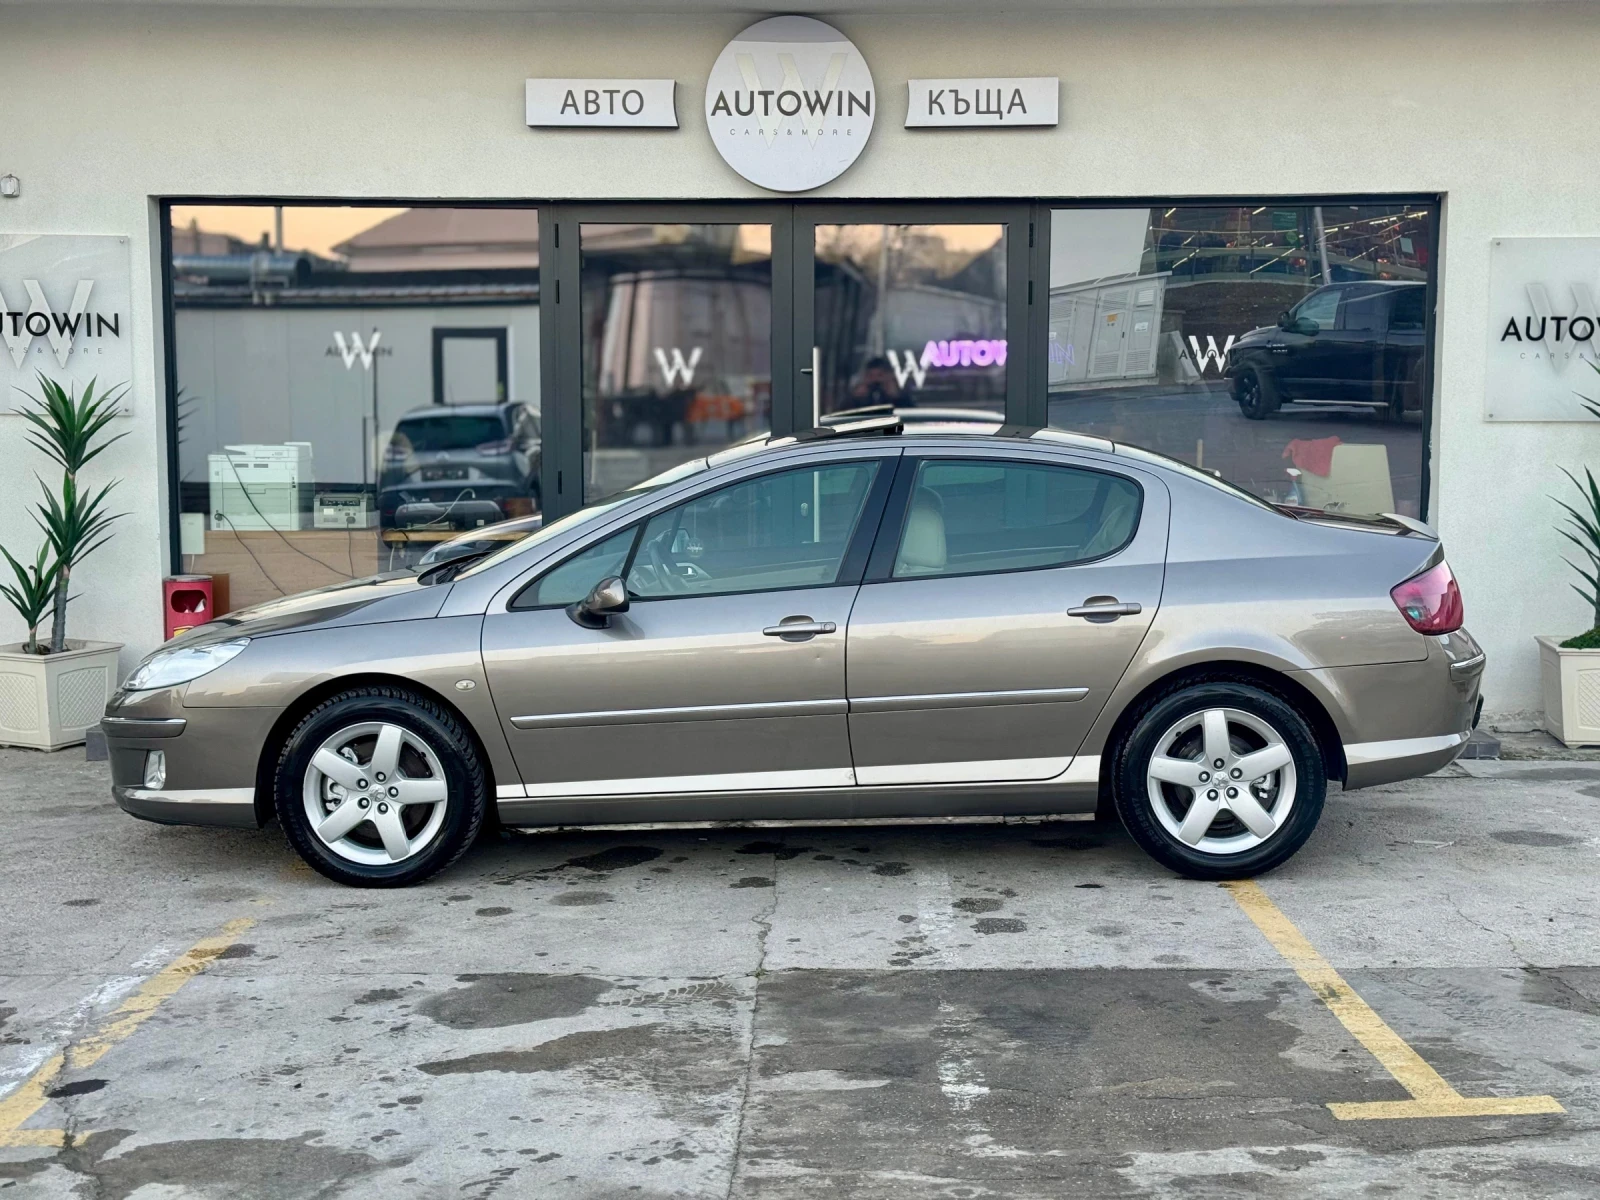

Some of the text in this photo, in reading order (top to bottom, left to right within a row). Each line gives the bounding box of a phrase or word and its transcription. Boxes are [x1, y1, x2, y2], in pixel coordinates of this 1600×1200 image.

[560, 89, 645, 116] АВТО
[710, 89, 871, 117] AUTOWIN
[928, 88, 1028, 120] КЪЩА
[0, 311, 120, 338] TOWIN
[1500, 316, 1600, 342] AUTO
[333, 330, 382, 371] W
[1188, 334, 1236, 374] W
[653, 346, 703, 388] W
